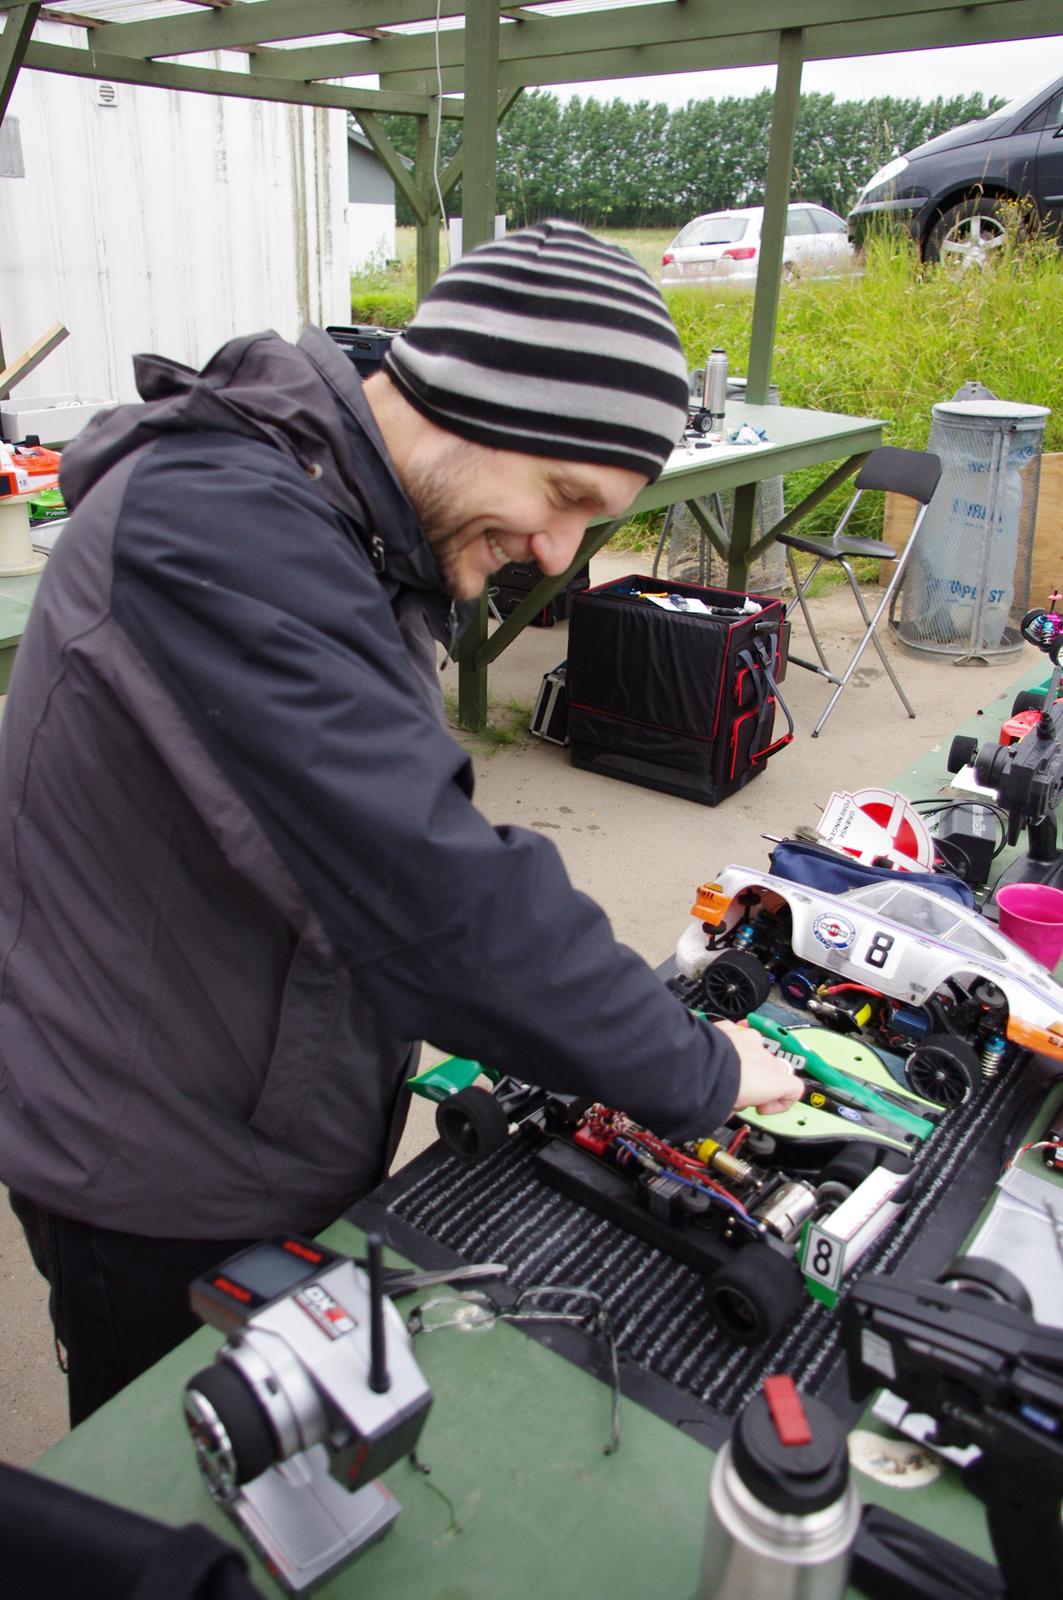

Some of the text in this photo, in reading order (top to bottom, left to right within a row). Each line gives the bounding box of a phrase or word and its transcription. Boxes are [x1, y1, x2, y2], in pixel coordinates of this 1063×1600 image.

[827, 799, 851, 841] FORENINGEN
[840, 810, 856, 839] GRÆNSE
[864, 930, 895, 969] 8
[813, 1238, 832, 1277] 8
